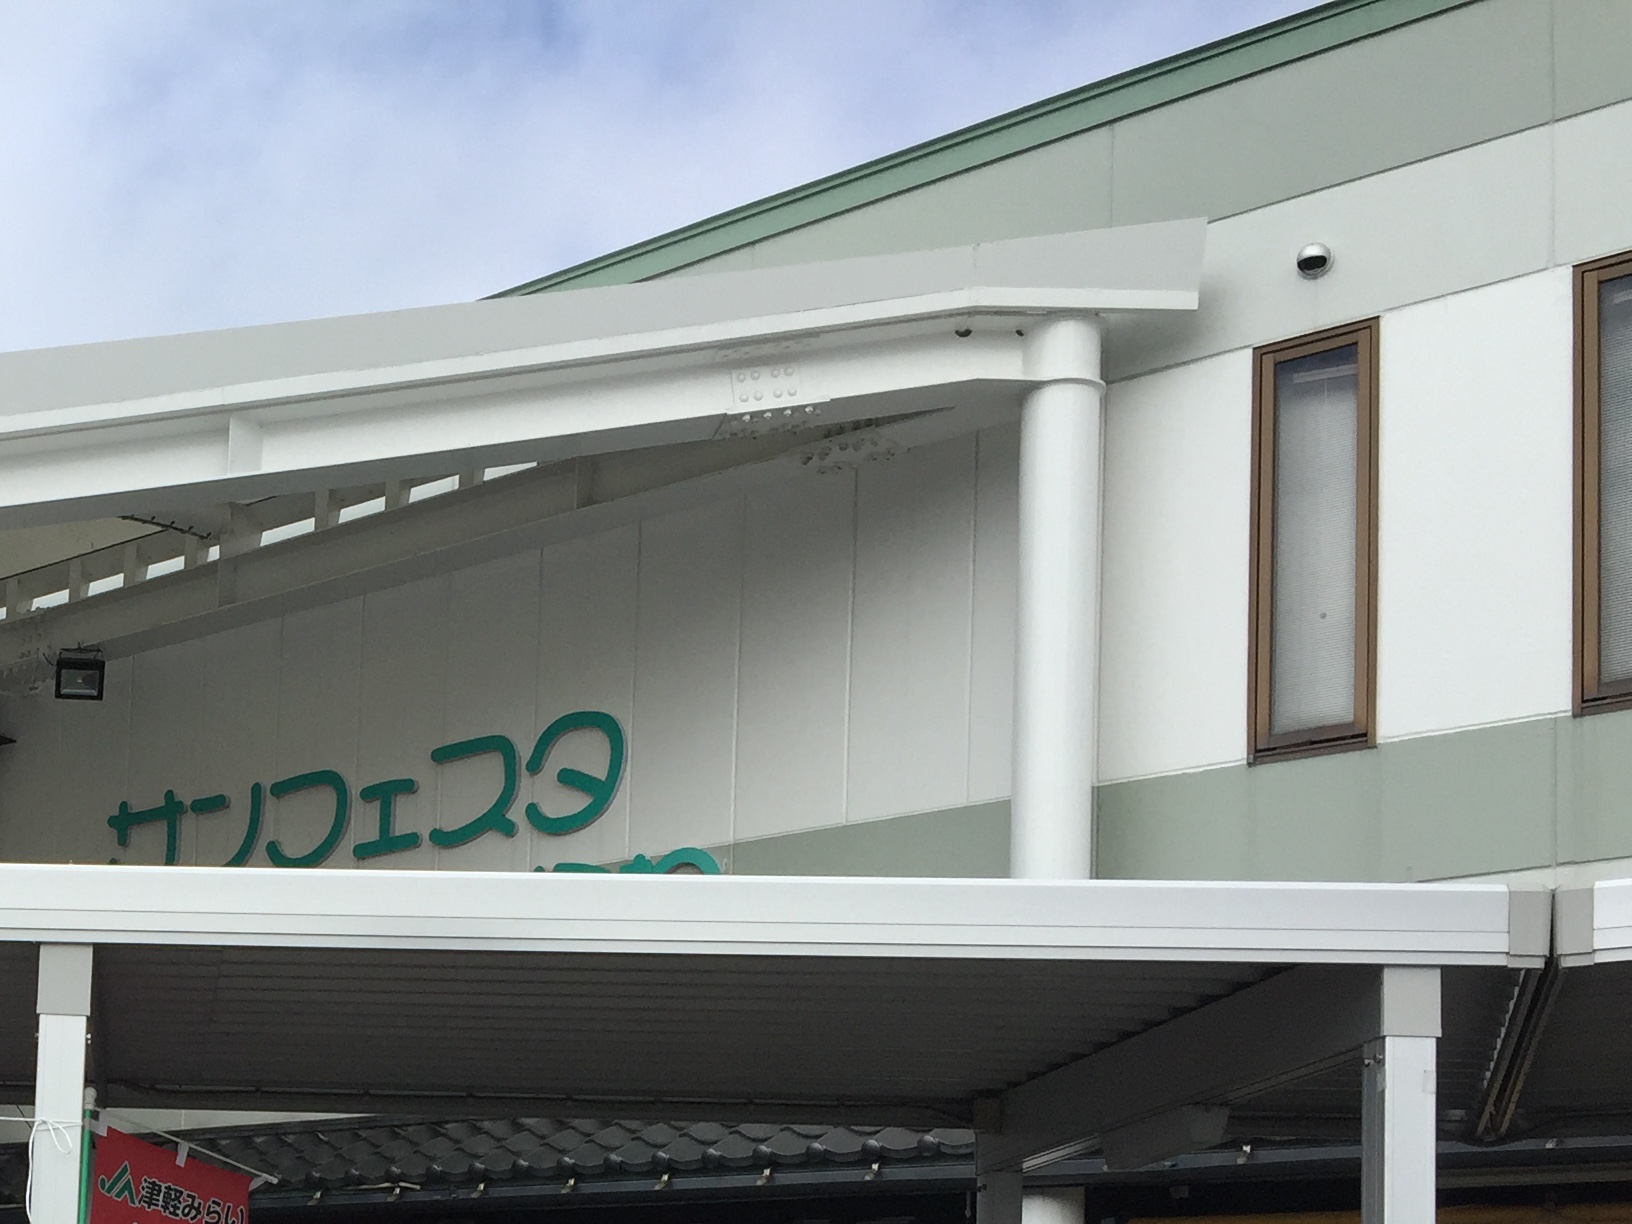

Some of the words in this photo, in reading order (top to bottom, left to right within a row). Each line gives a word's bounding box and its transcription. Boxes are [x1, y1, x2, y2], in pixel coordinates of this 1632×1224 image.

[107, 711, 625, 868] サンフェスタ
